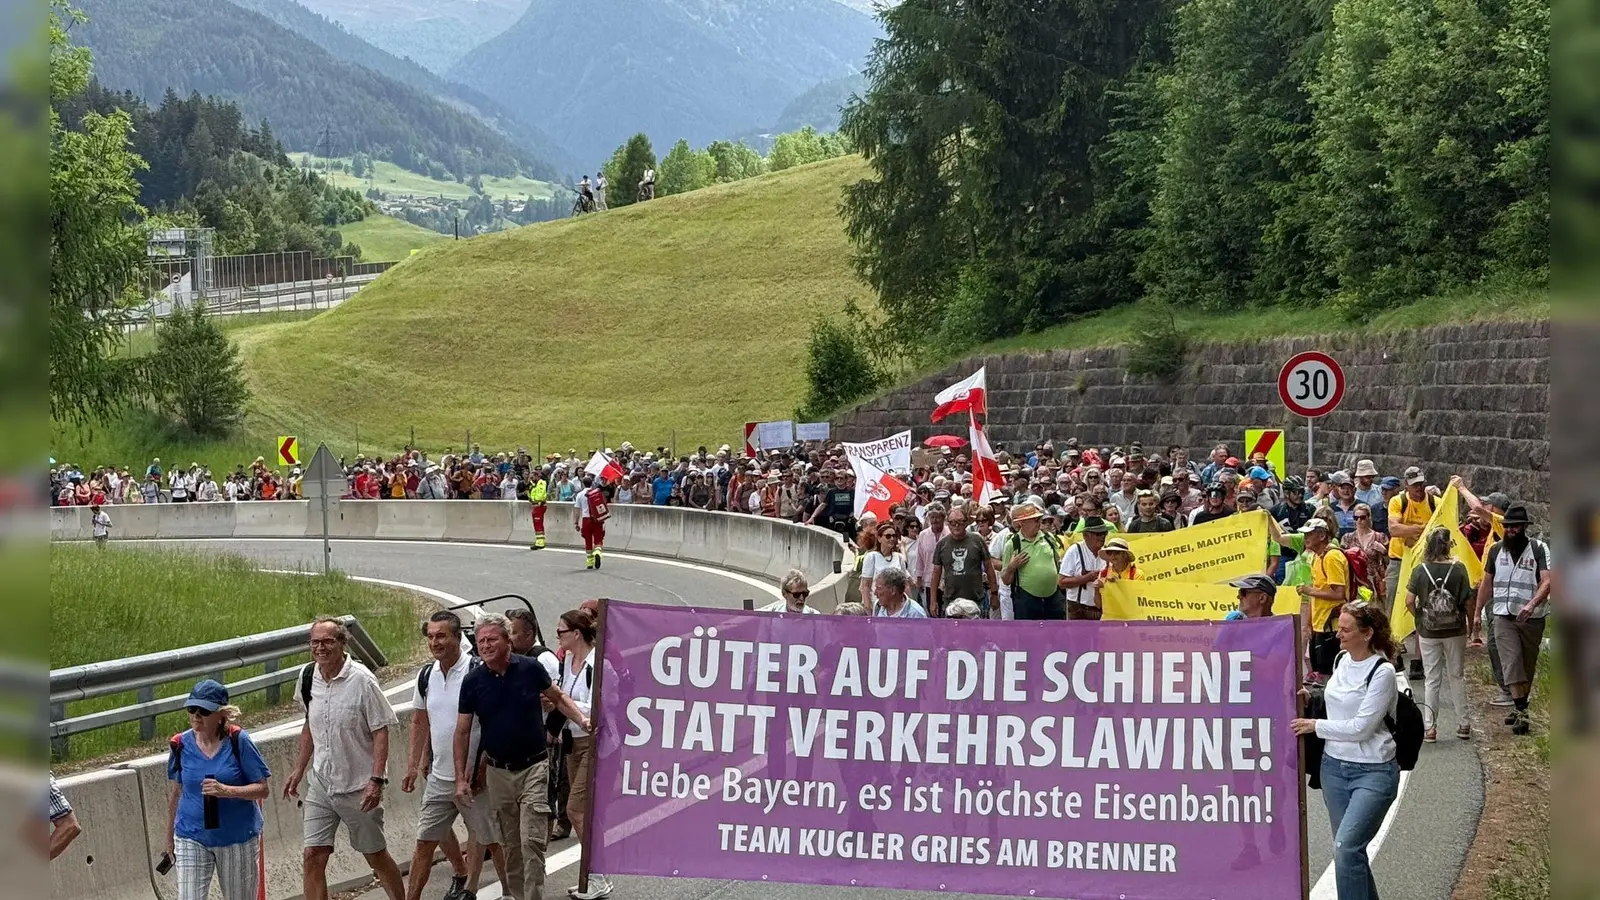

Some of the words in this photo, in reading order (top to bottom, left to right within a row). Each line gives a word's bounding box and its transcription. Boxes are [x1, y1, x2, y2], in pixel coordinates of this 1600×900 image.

[1295, 369, 1329, 400] 30
[866, 453, 892, 468] TATT
[1137, 543, 1195, 564] STAUFREI,
[1196, 528, 1253, 550] MAUTFREI
[1145, 569, 1172, 582] eren
[1174, 551, 1246, 576] Lebensraum
[1137, 596, 1184, 609] Mensch
[1187, 601, 1207, 611] vor
[1209, 600, 1239, 612] Verk
[650, 625, 819, 695] GÜTER
[830, 646, 930, 699] AUF
[945, 650, 1028, 702] DIE
[1041, 650, 1252, 704] SCHIENE
[623, 696, 776, 755] STATT
[788, 707, 1273, 772] VERKEHRSLAWINE!
[621, 759, 712, 800] Liebe
[722, 766, 848, 815] Bayern,
[858, 781, 893, 812] es
[903, 776, 945, 814] ist
[953, 777, 1083, 820] höchste
[1093, 782, 1274, 824] Eisenbahn!
[717, 823, 791, 855] TEAM
[798, 828, 905, 862] KUGLER
[910, 834, 992, 866] GRIES
[995, 838, 1039, 868] AM
[1046, 840, 1177, 873] BRENNER
